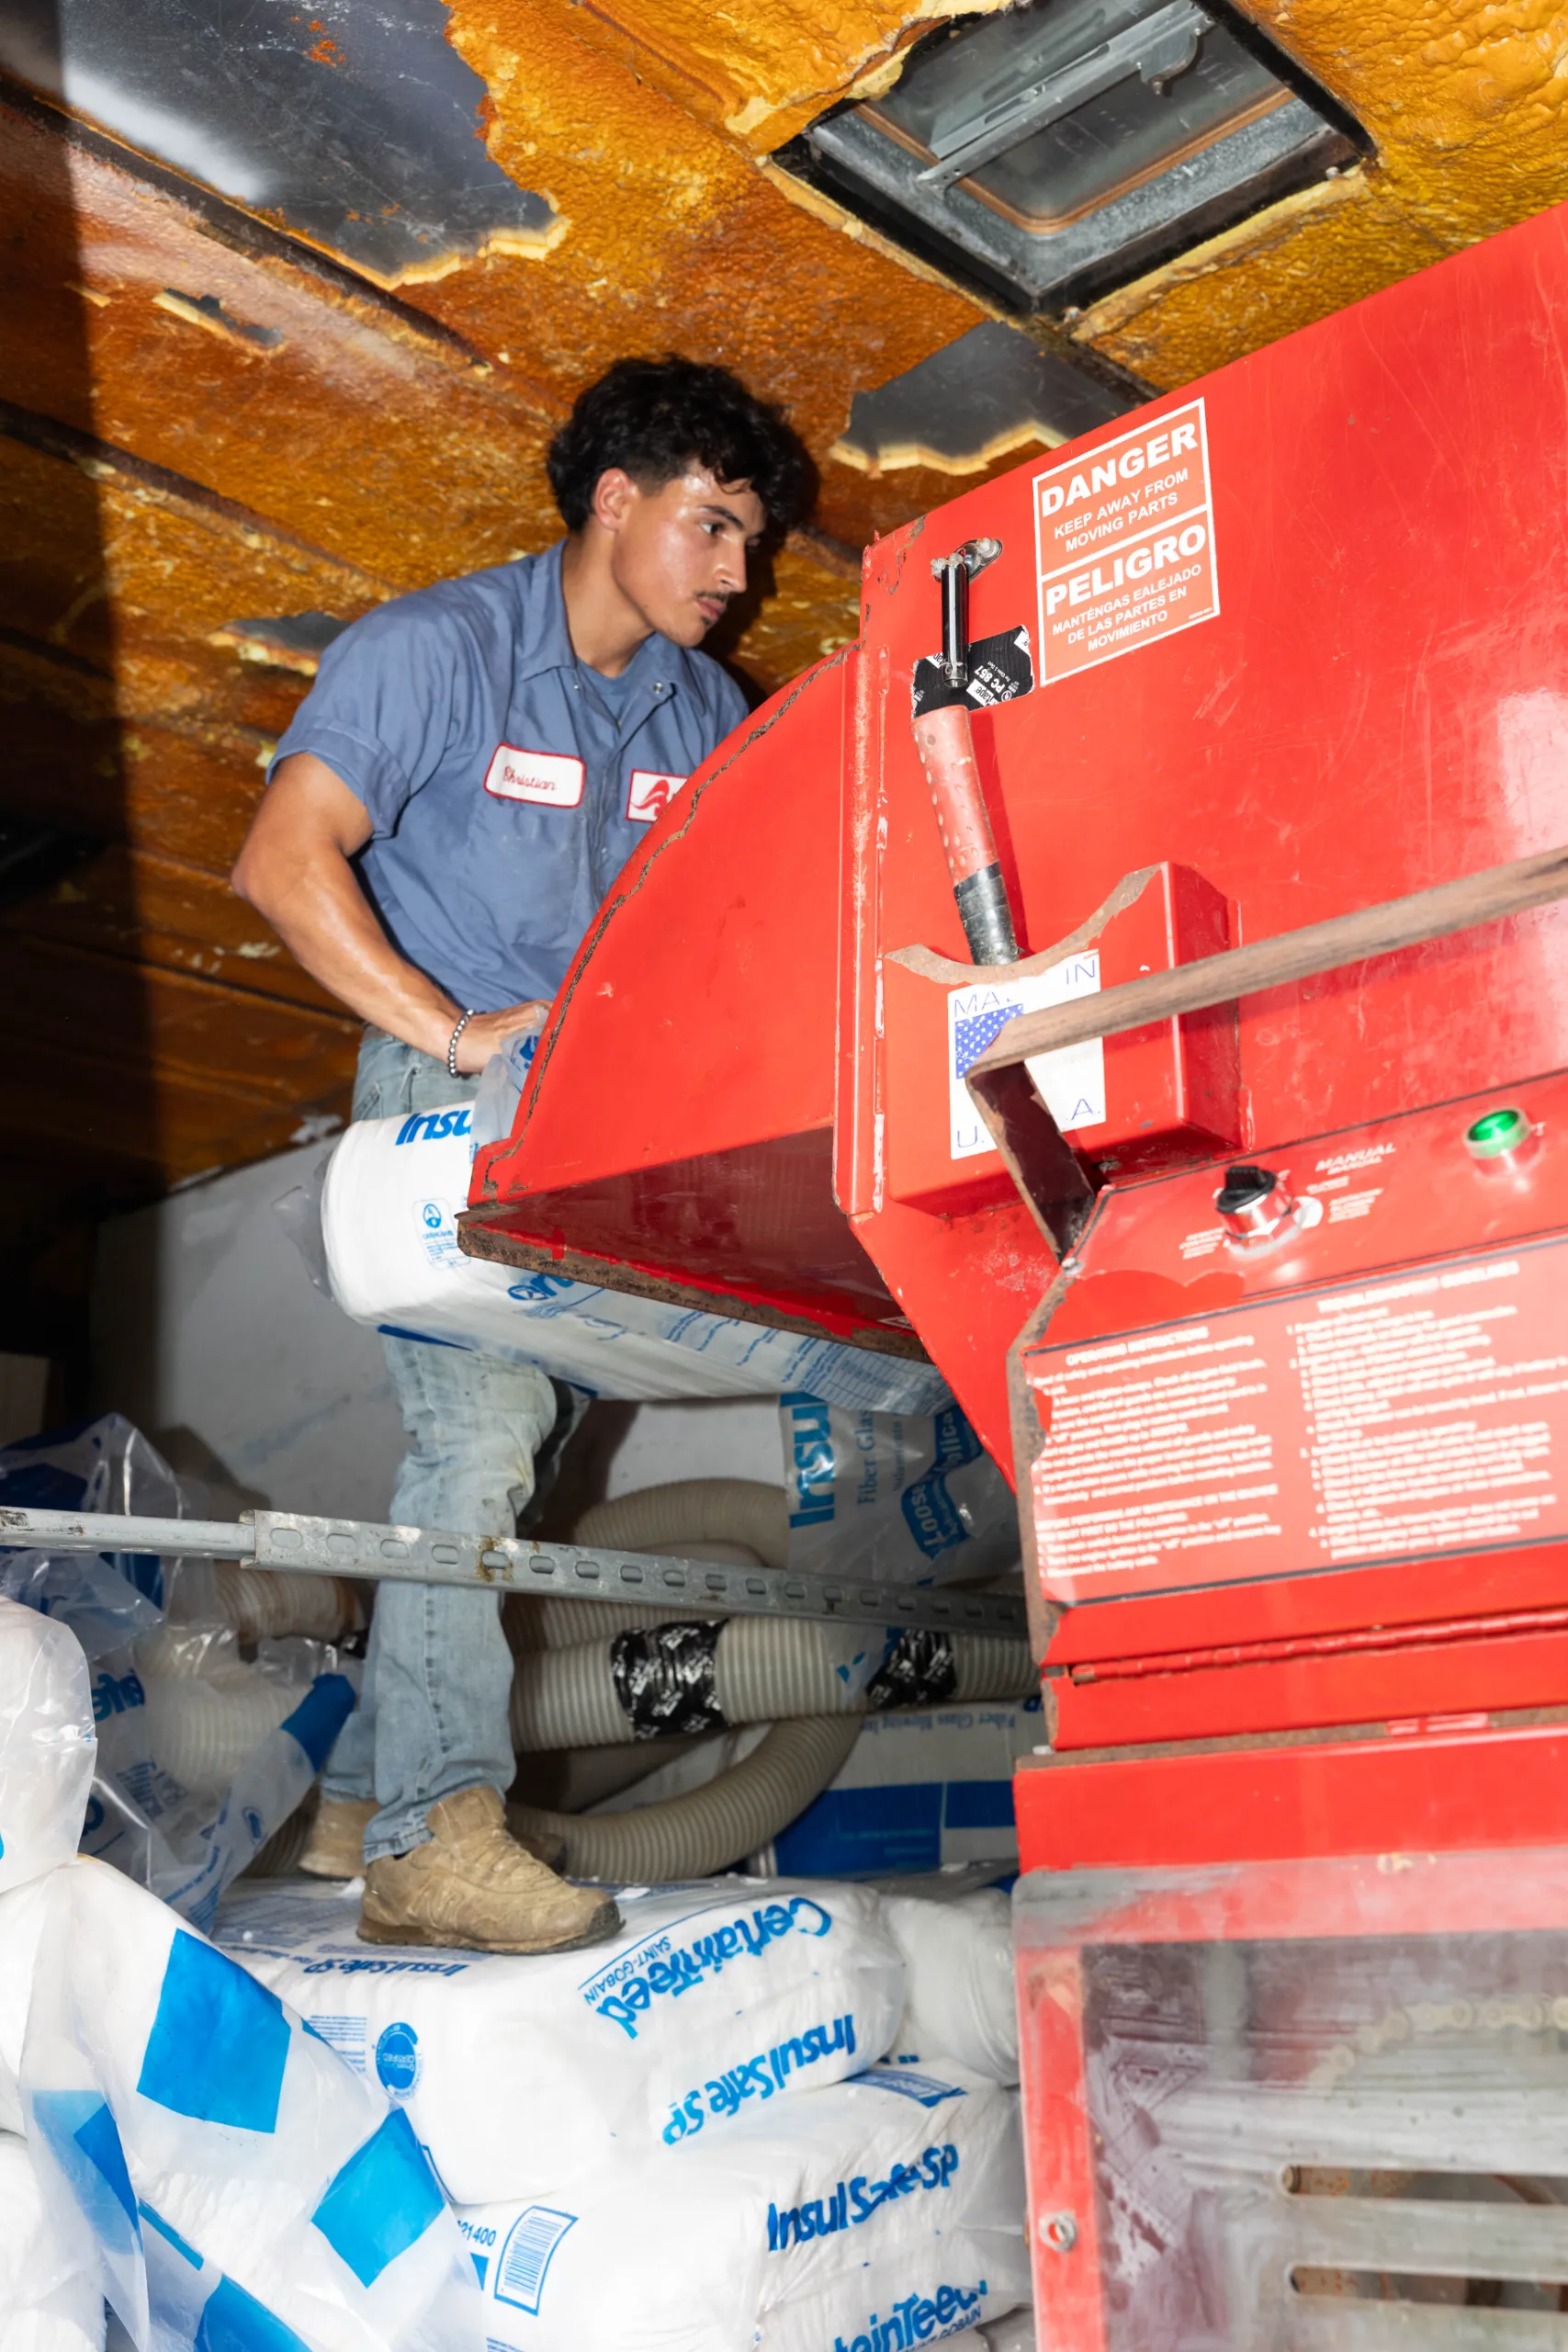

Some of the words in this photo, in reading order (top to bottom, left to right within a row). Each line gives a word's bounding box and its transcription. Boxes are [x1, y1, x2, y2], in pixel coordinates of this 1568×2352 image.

[1042, 423, 1198, 518] DANGER
[1055, 512, 1092, 539] KEEP
[1097, 490, 1141, 520] AWAY
[1145, 468, 1188, 498] FROM
[1066, 517, 1123, 552] MOVING
[1128, 492, 1178, 525] PARTS
[1046, 525, 1205, 616] PELIGRO
[1134, 564, 1201, 602] EALEJADO
[1068, 628, 1085, 644] DE
[1088, 617, 1112, 636] LAS
[1115, 596, 1166, 626] PARTES
[1169, 586, 1188, 603] EN
[1088, 610, 1168, 652] MOVIMIENTO
[974, 665, 992, 683] 857
[992, 679, 1006, 694] PC
[502, 765, 557, 791] Christian
[1066, 960, 1096, 985] IN
[1314, 1143, 1396, 1172] MANUAL
[856, 1459, 877, 1505] Fiber
[583, 1935, 671, 2006] SAINT-GOBAIN
[596, 1897, 832, 2041] CertainTeed
[704, 2013, 856, 2118] InsulSafe
[662, 2089, 705, 2146] SP
[767, 2163, 921, 2252] InsulSafe
[922, 2143, 959, 2190] SP
